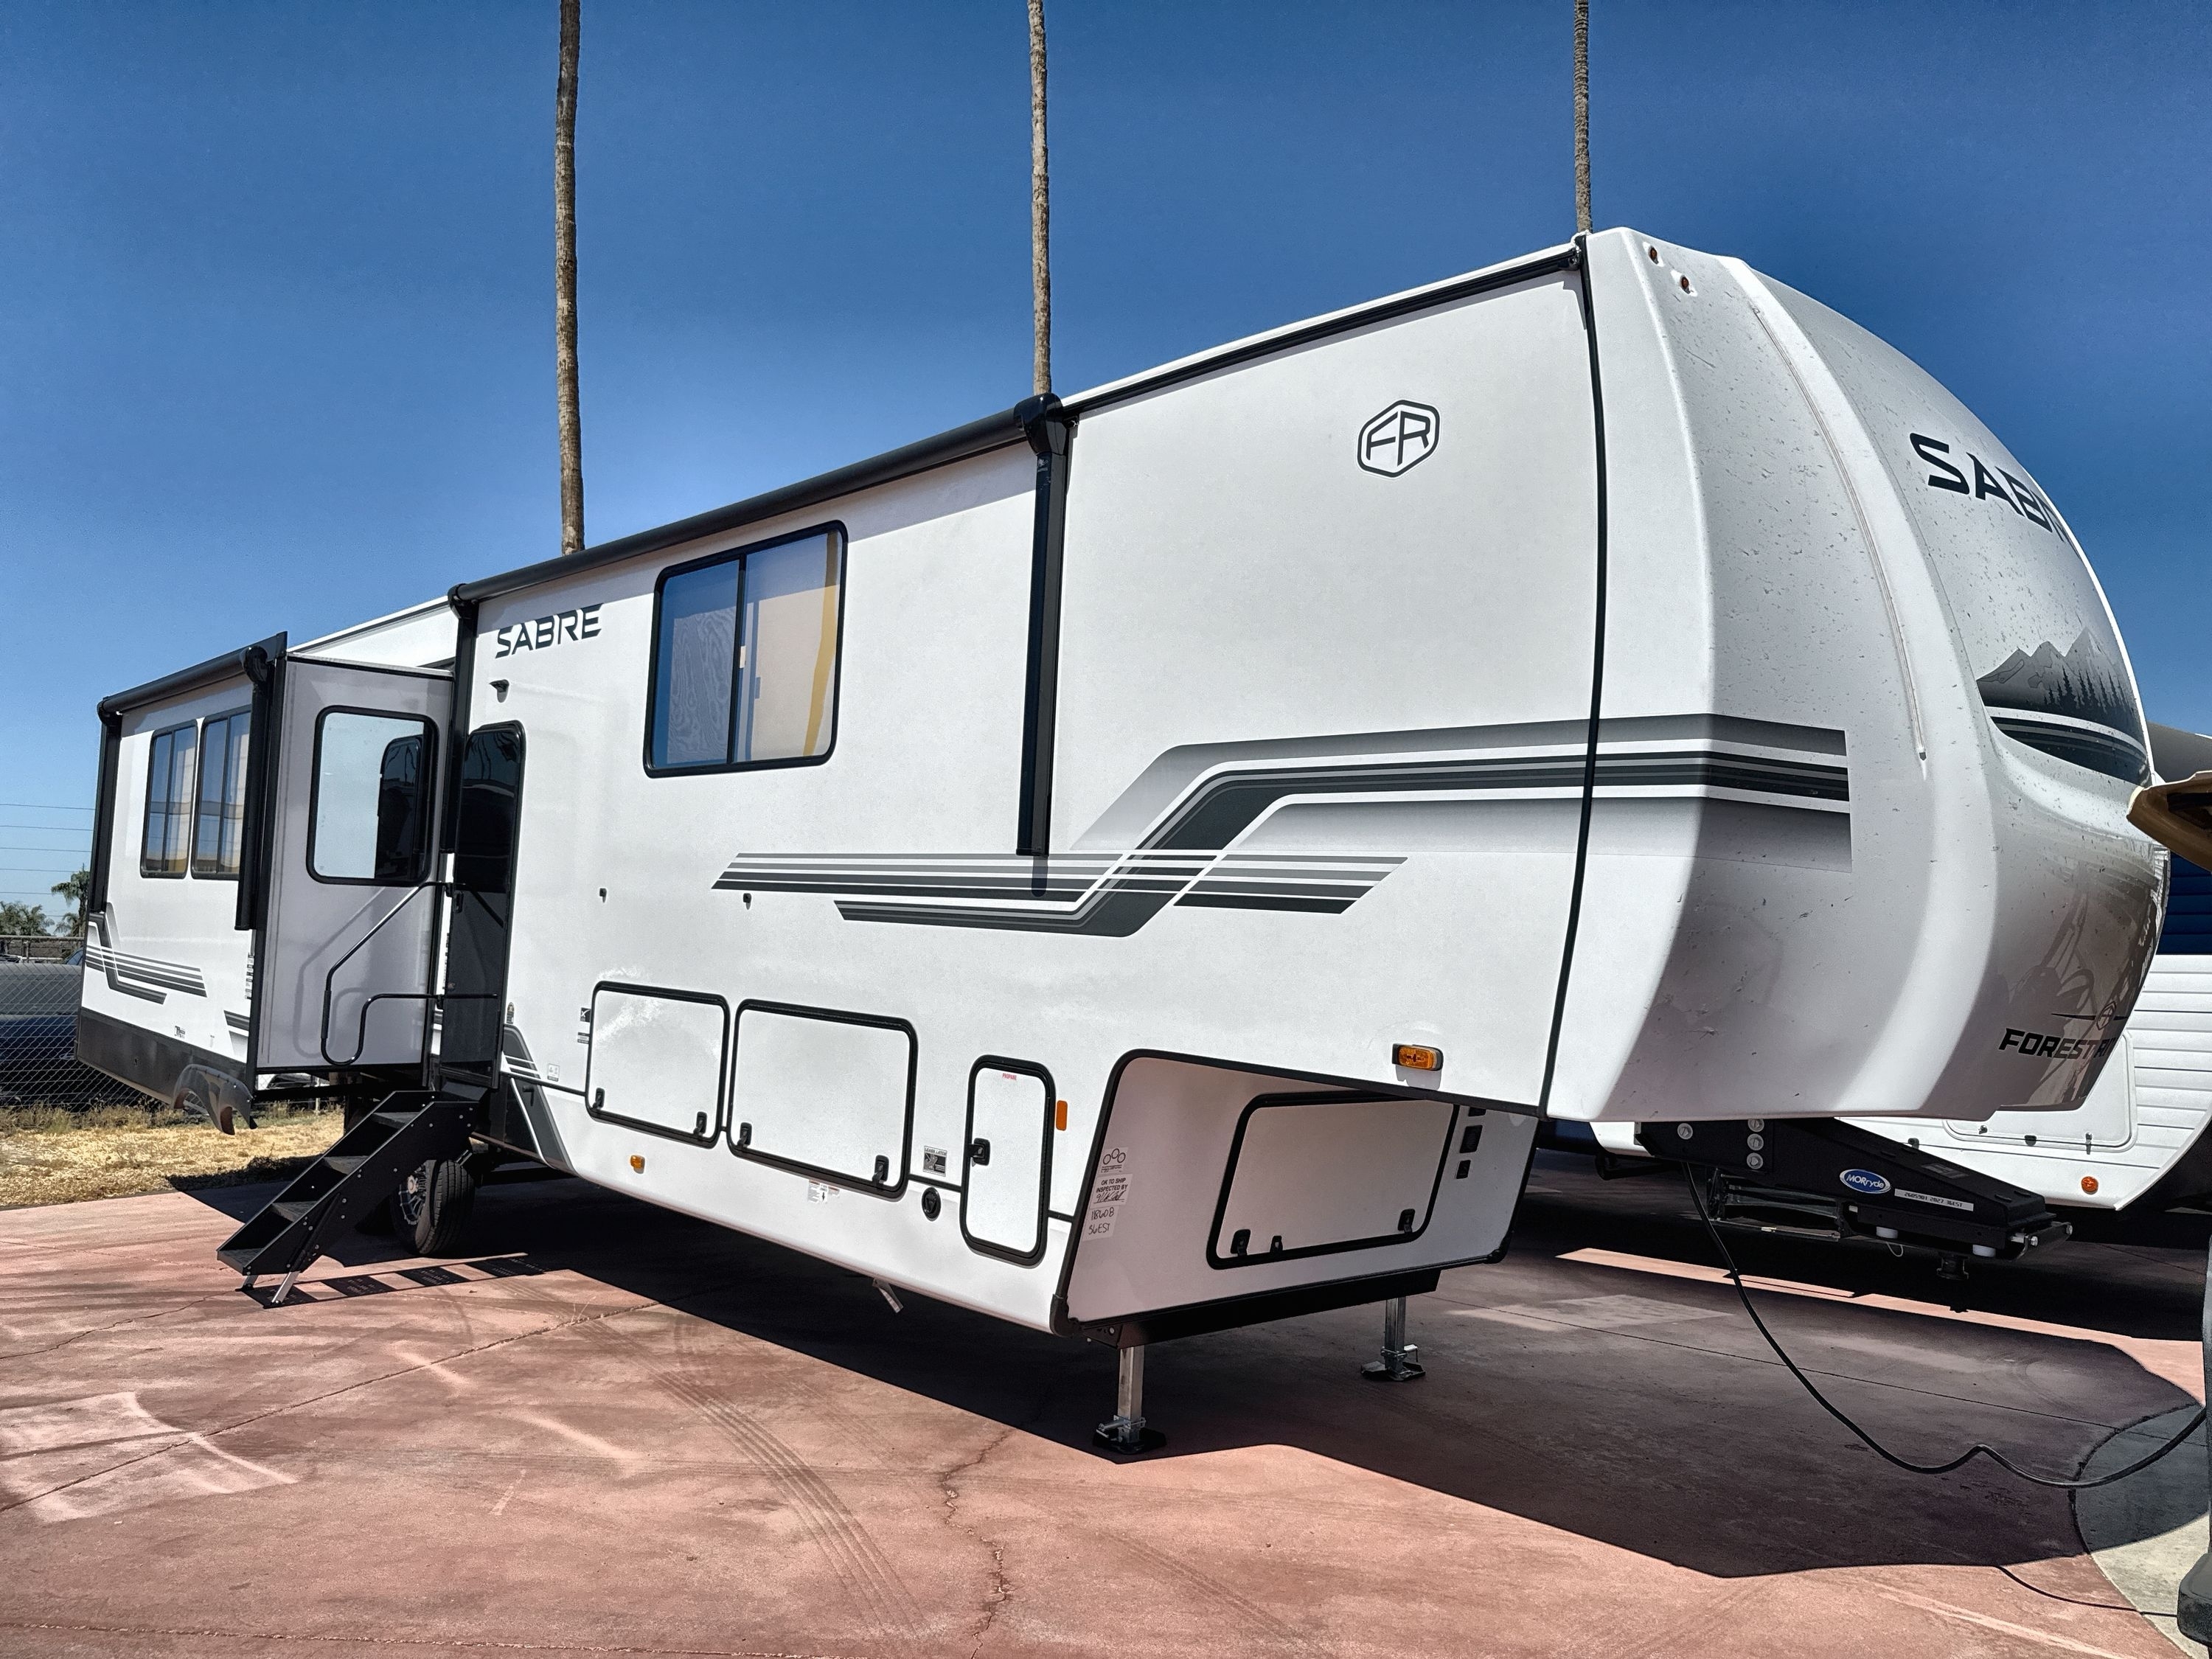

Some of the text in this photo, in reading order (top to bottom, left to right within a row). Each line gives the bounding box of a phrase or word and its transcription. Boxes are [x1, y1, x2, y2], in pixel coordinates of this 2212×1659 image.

[495, 602, 604, 658] SABRE
[1999, 1028, 2101, 1060] FOREST
[1096, 1185, 1121, 1193] INSPECTED
[1846, 1174, 1885, 1189] MORryde
